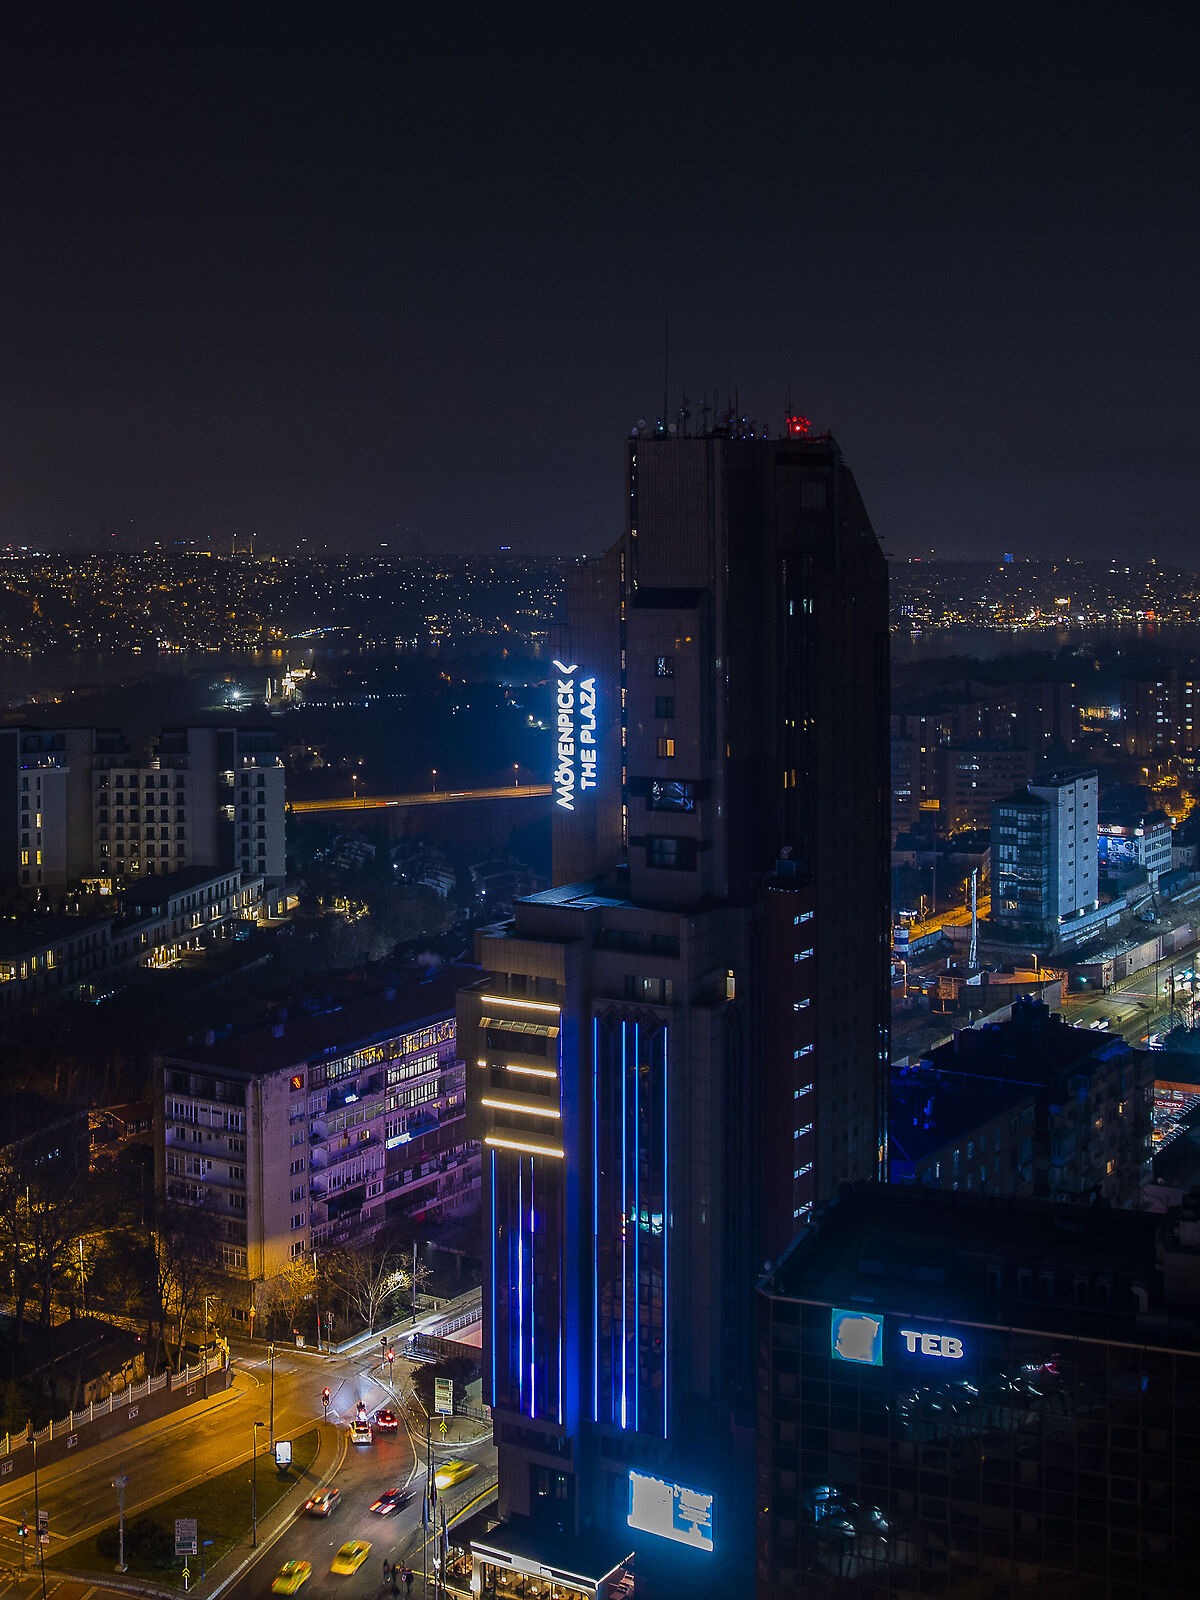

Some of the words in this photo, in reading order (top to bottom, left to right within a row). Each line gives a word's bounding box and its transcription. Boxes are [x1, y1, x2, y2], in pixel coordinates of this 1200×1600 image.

[580, 677, 596, 744] PLAZA
[554, 679, 575, 811] MÖVENPICK
[580, 749, 597, 790] THE
[900, 1330, 964, 1359] TEB
